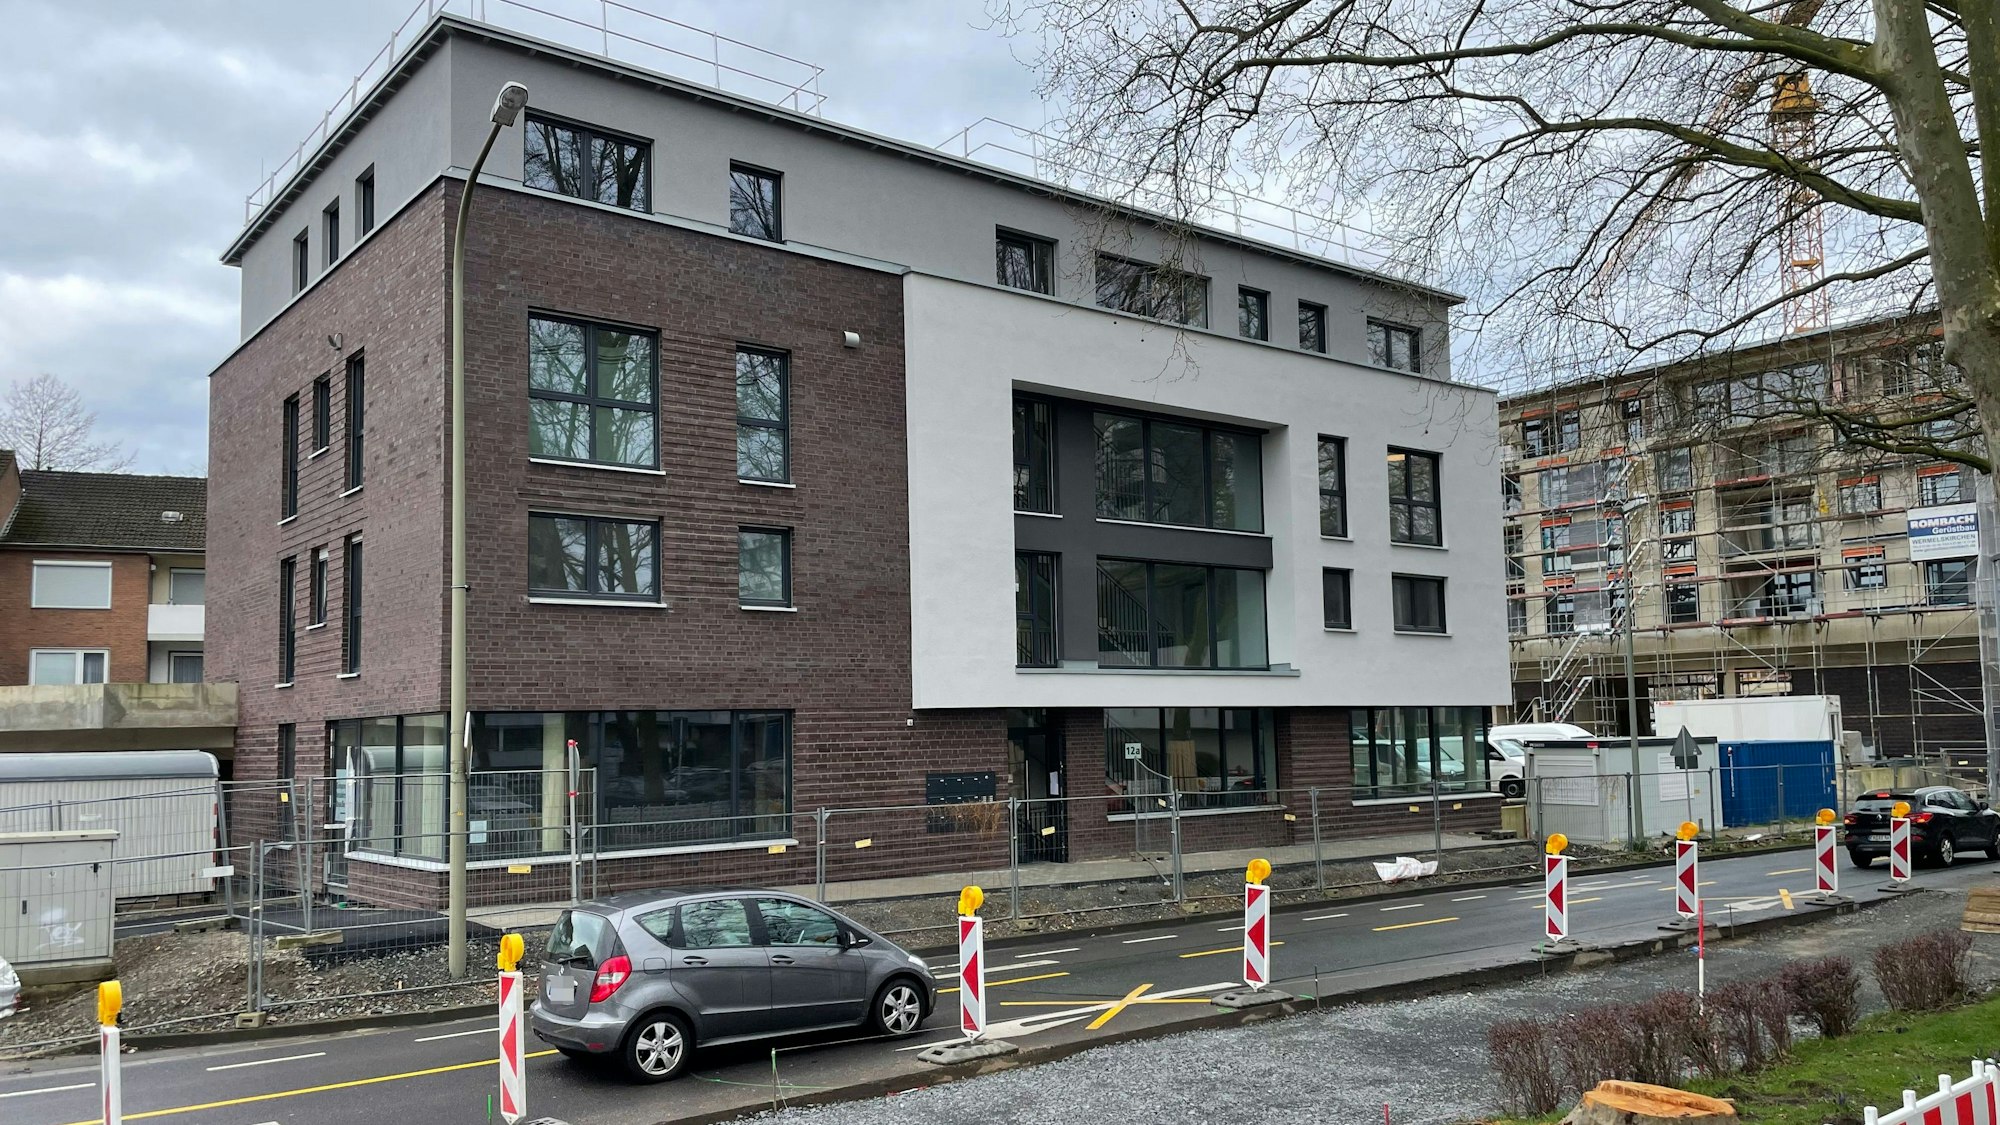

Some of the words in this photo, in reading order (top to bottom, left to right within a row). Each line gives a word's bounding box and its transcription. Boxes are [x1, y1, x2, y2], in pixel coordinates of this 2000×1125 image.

[1910, 515, 1975, 529] ROMBACH
[1932, 524, 1976, 534] Gerüstbau
[1912, 534, 1976, 545] WERMELSKIRCHEN
[1126, 746, 1140, 755] 12a
